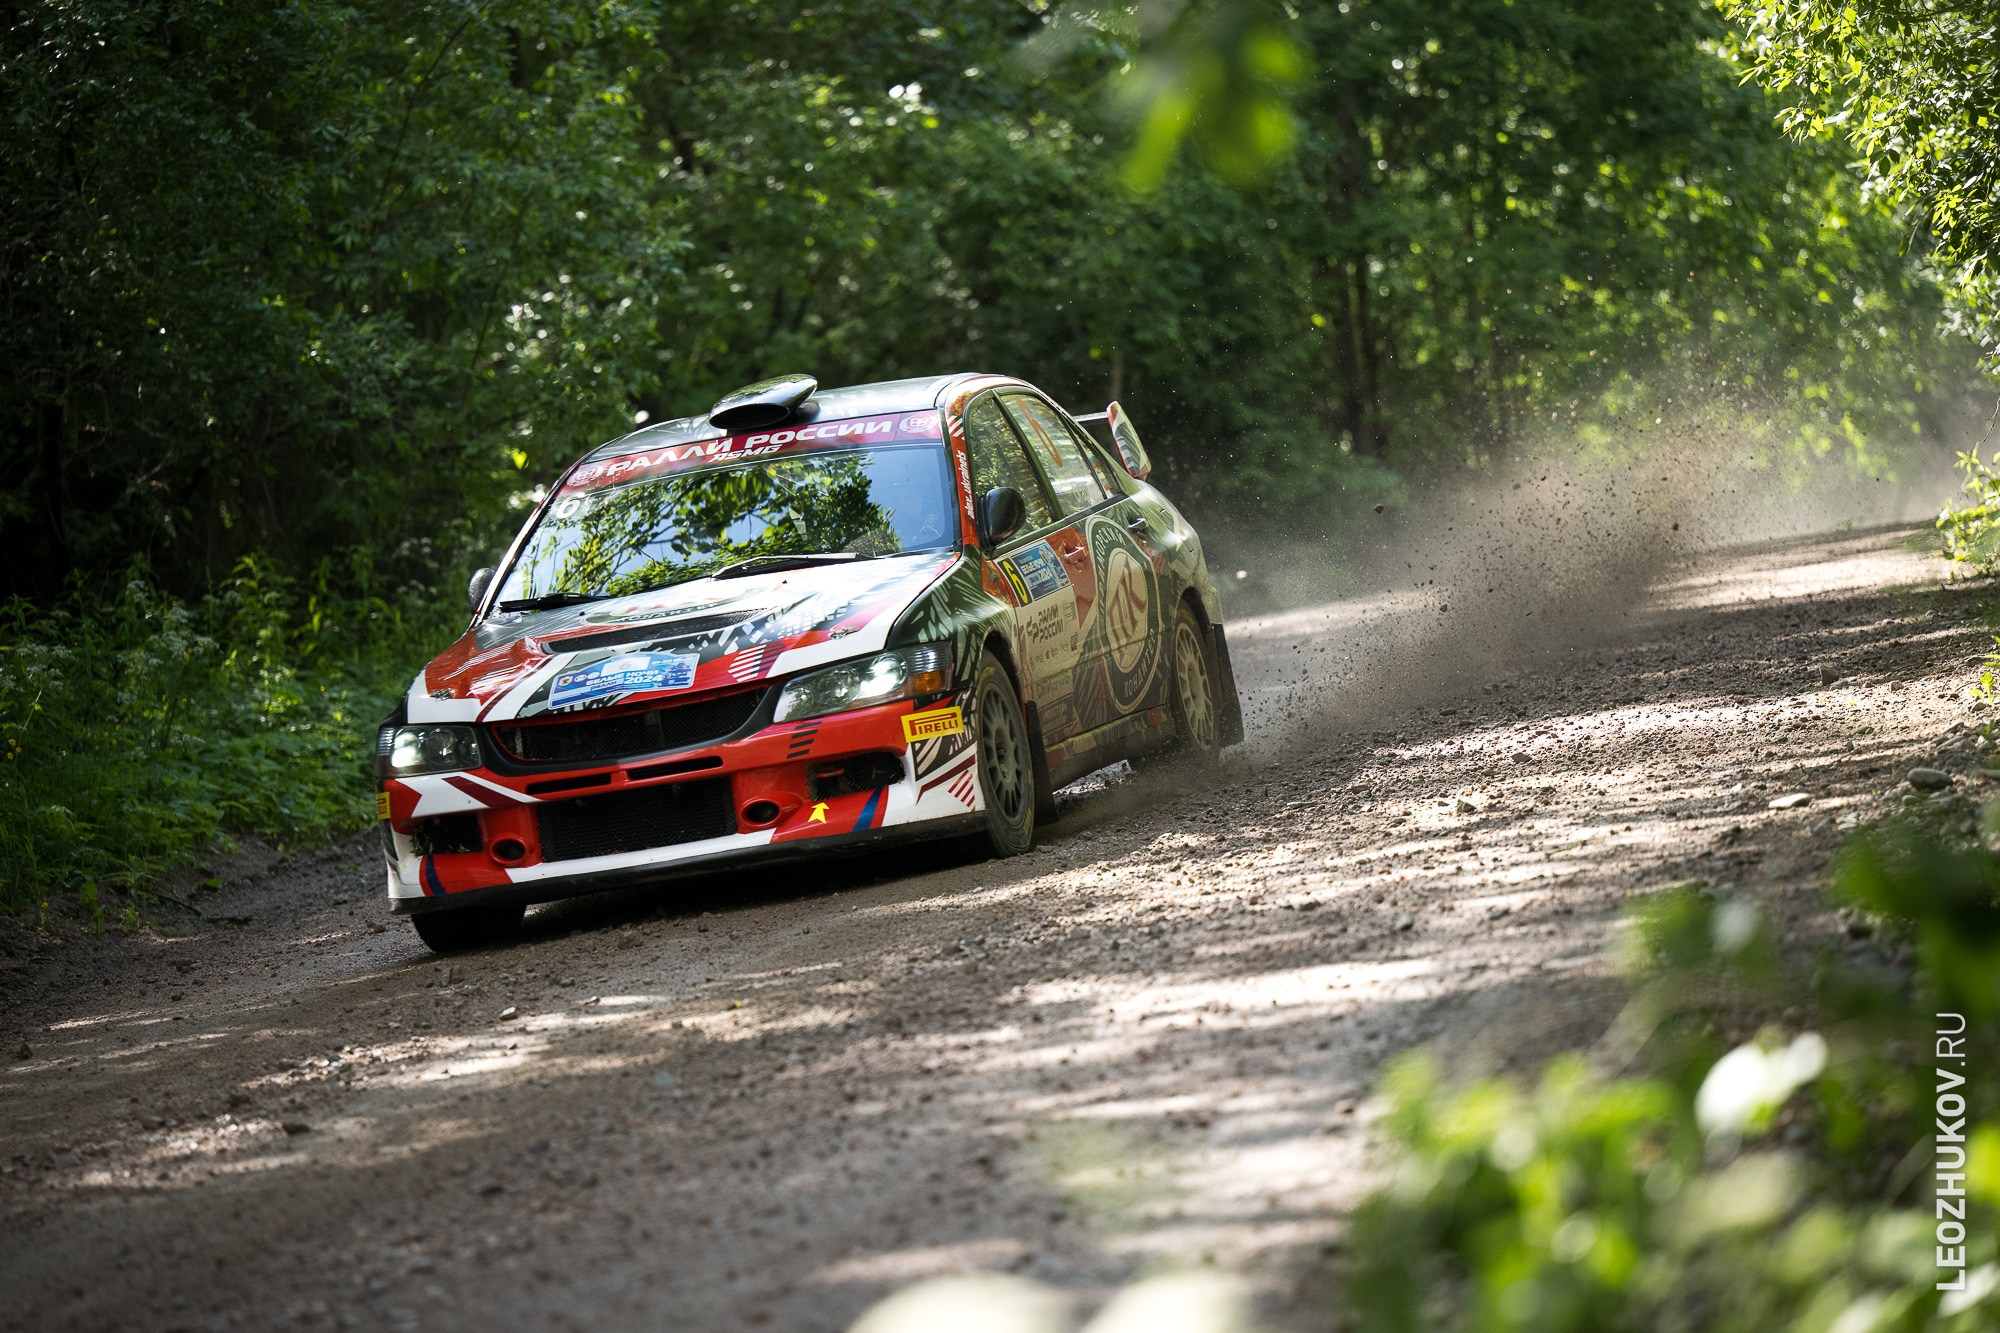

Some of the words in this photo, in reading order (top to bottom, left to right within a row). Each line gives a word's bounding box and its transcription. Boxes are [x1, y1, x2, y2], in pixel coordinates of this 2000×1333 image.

[606, 438, 733, 476] РАЛЛИ
[745, 421, 892, 449] РОССИИ
[1016, 396, 1063, 468] 6
[556, 492, 585, 519] 6
[1003, 561, 1028, 604] 6
[1095, 527, 1127, 617] ПРИМОРСКИЙ
[624, 674, 665, 684] 2024
[626, 669, 659, 678] НОЧИ
[1125, 629, 1156, 698] КОНДИТЕР
[909, 712, 959, 737] PIRELLI
